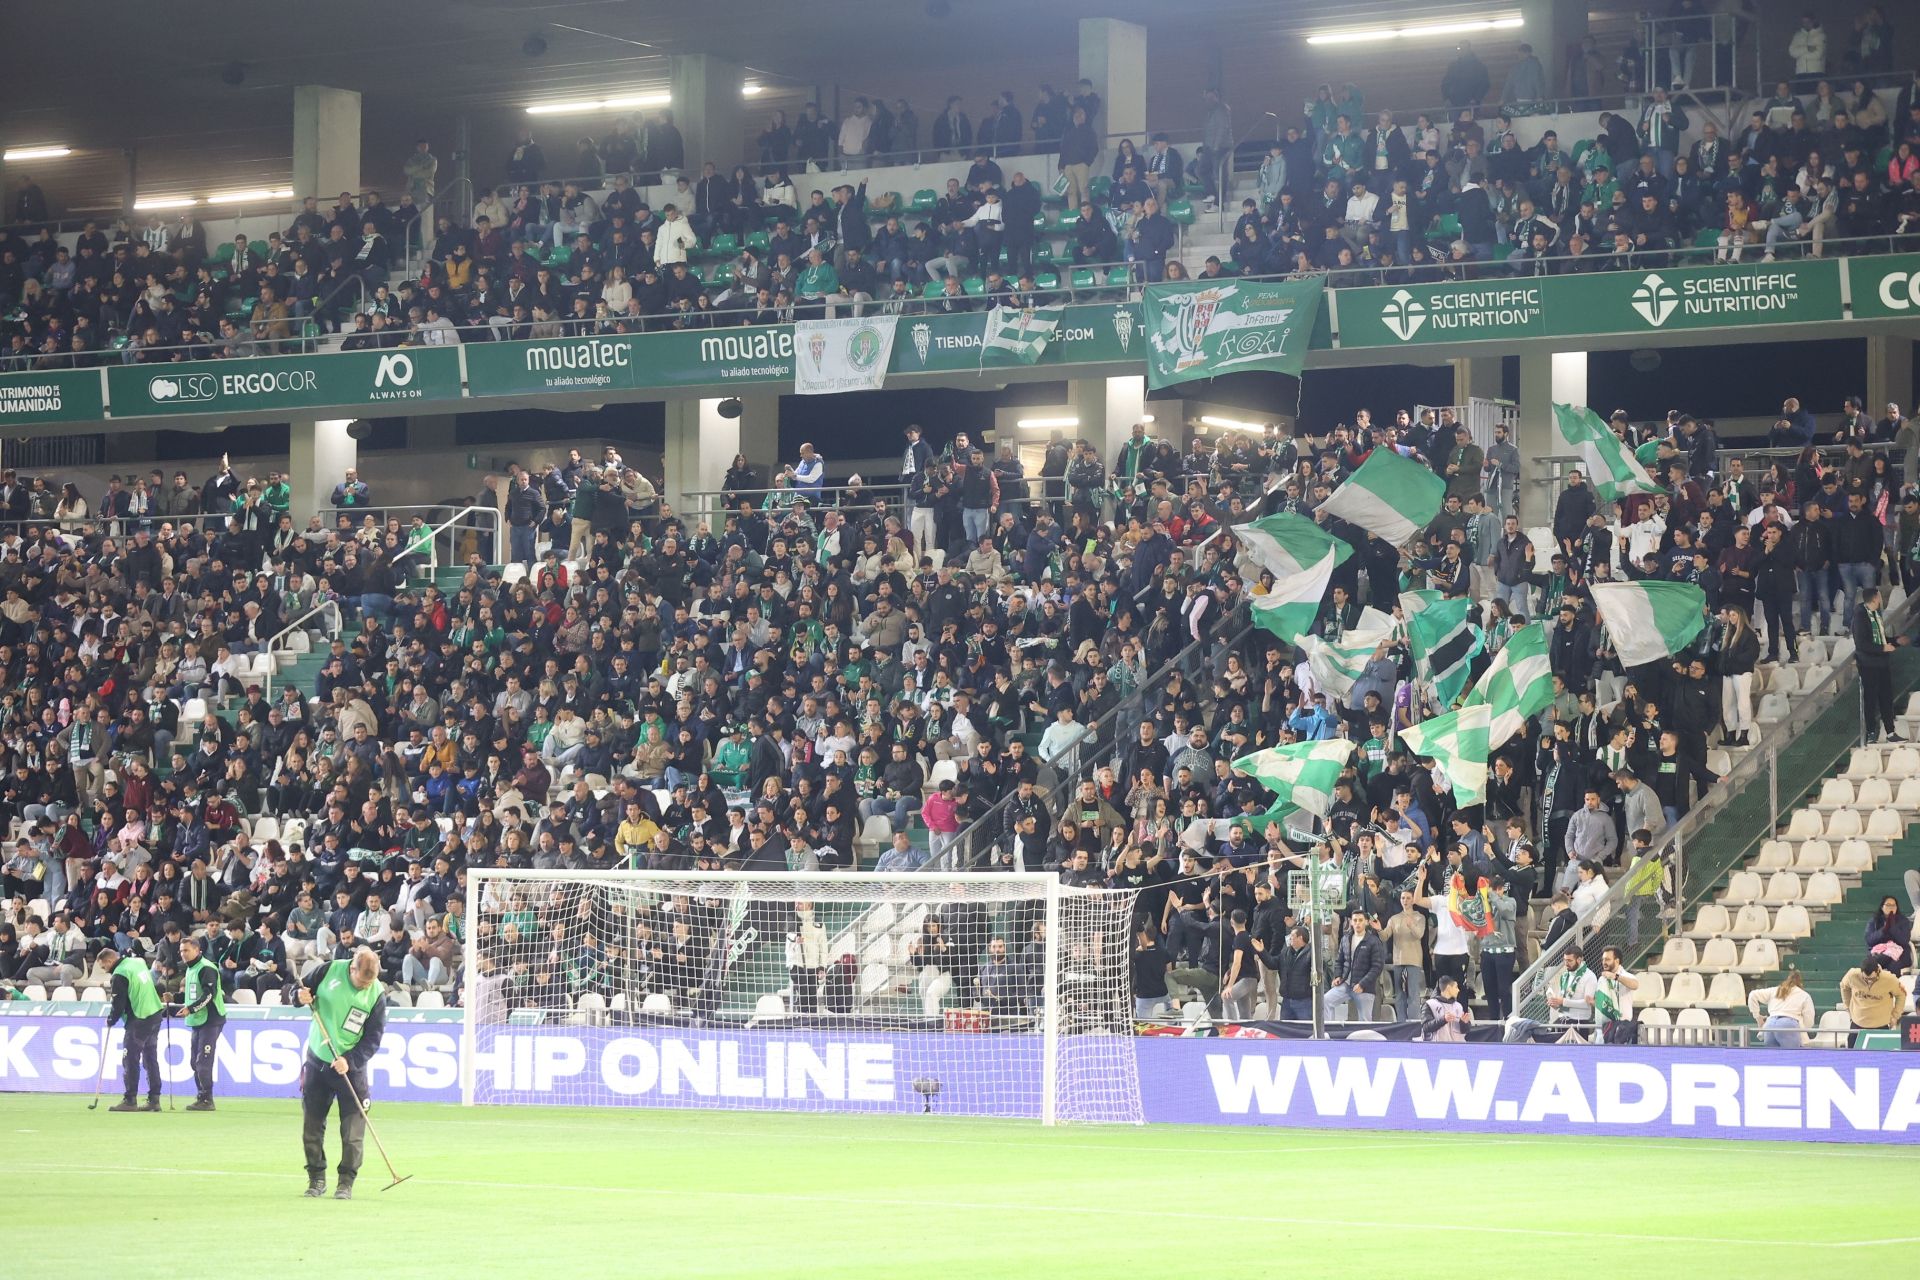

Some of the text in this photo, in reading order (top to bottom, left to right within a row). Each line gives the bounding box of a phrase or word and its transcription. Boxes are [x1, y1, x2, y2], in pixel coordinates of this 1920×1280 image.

[1683, 273, 1797, 295] SCIENTIFFIC
[1431, 289, 1538, 310] SCIENTIFFIC
[1245, 313, 1281, 326] Infantil
[935, 334, 982, 349] TIENDA
[721, 364, 789, 377] tu aliado tecnológico
[178, 376, 213, 399] LSC
[222, 370, 317, 395] ERGOCOR
[546, 374, 611, 386] tu aliado tecnológico
[370, 389, 422, 399] ALWAYS ON
[600, 1036, 895, 1101] ONLINE
